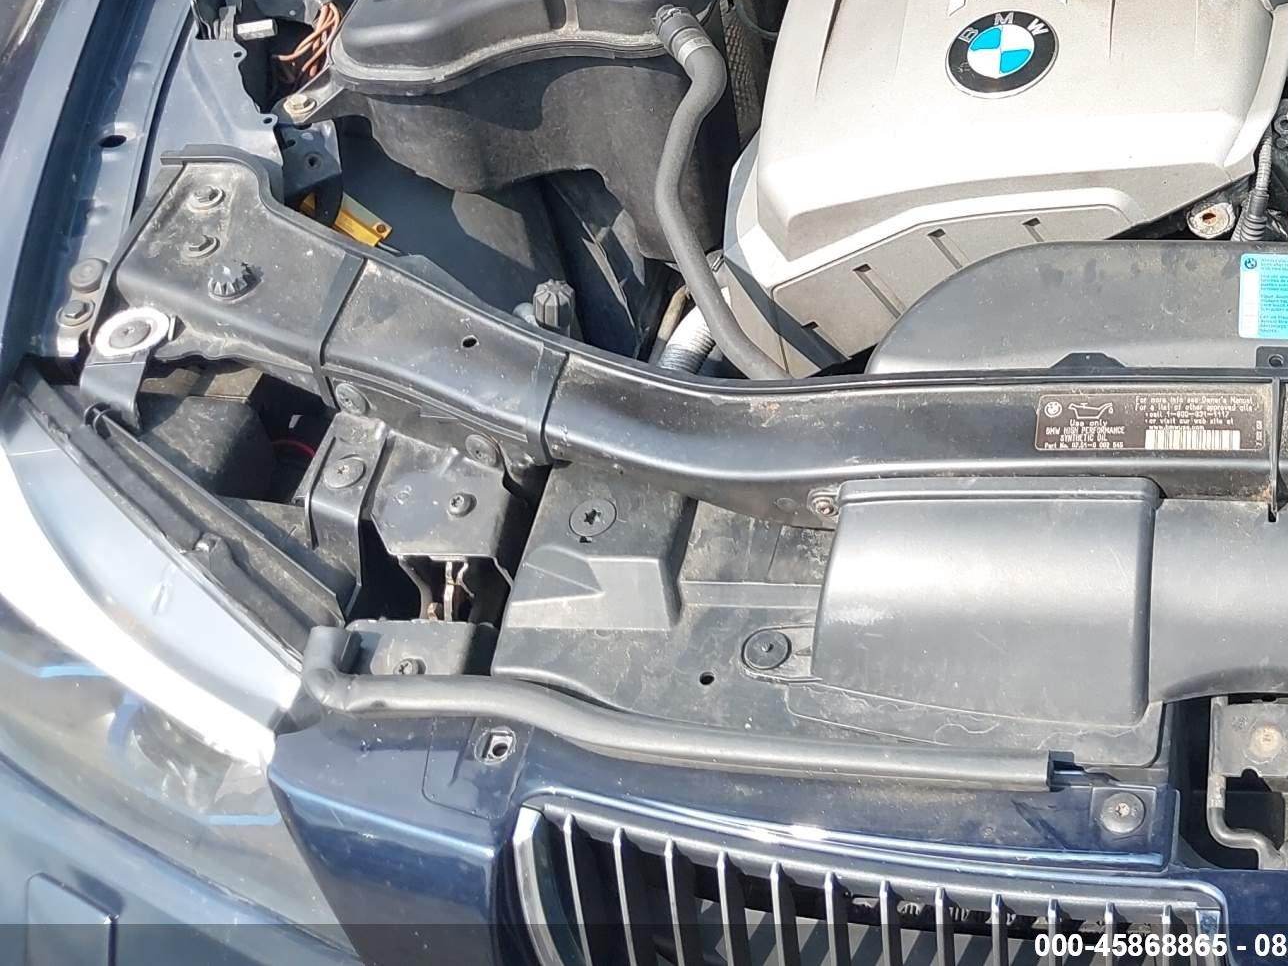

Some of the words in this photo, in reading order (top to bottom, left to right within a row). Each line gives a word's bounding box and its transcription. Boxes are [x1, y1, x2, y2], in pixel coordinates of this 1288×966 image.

[958, 12, 1049, 44] BMW
[1090, 419, 1108, 427] only
[1045, 427, 1061, 435] BMW
[1081, 426, 1126, 435] PERFORMANCE
